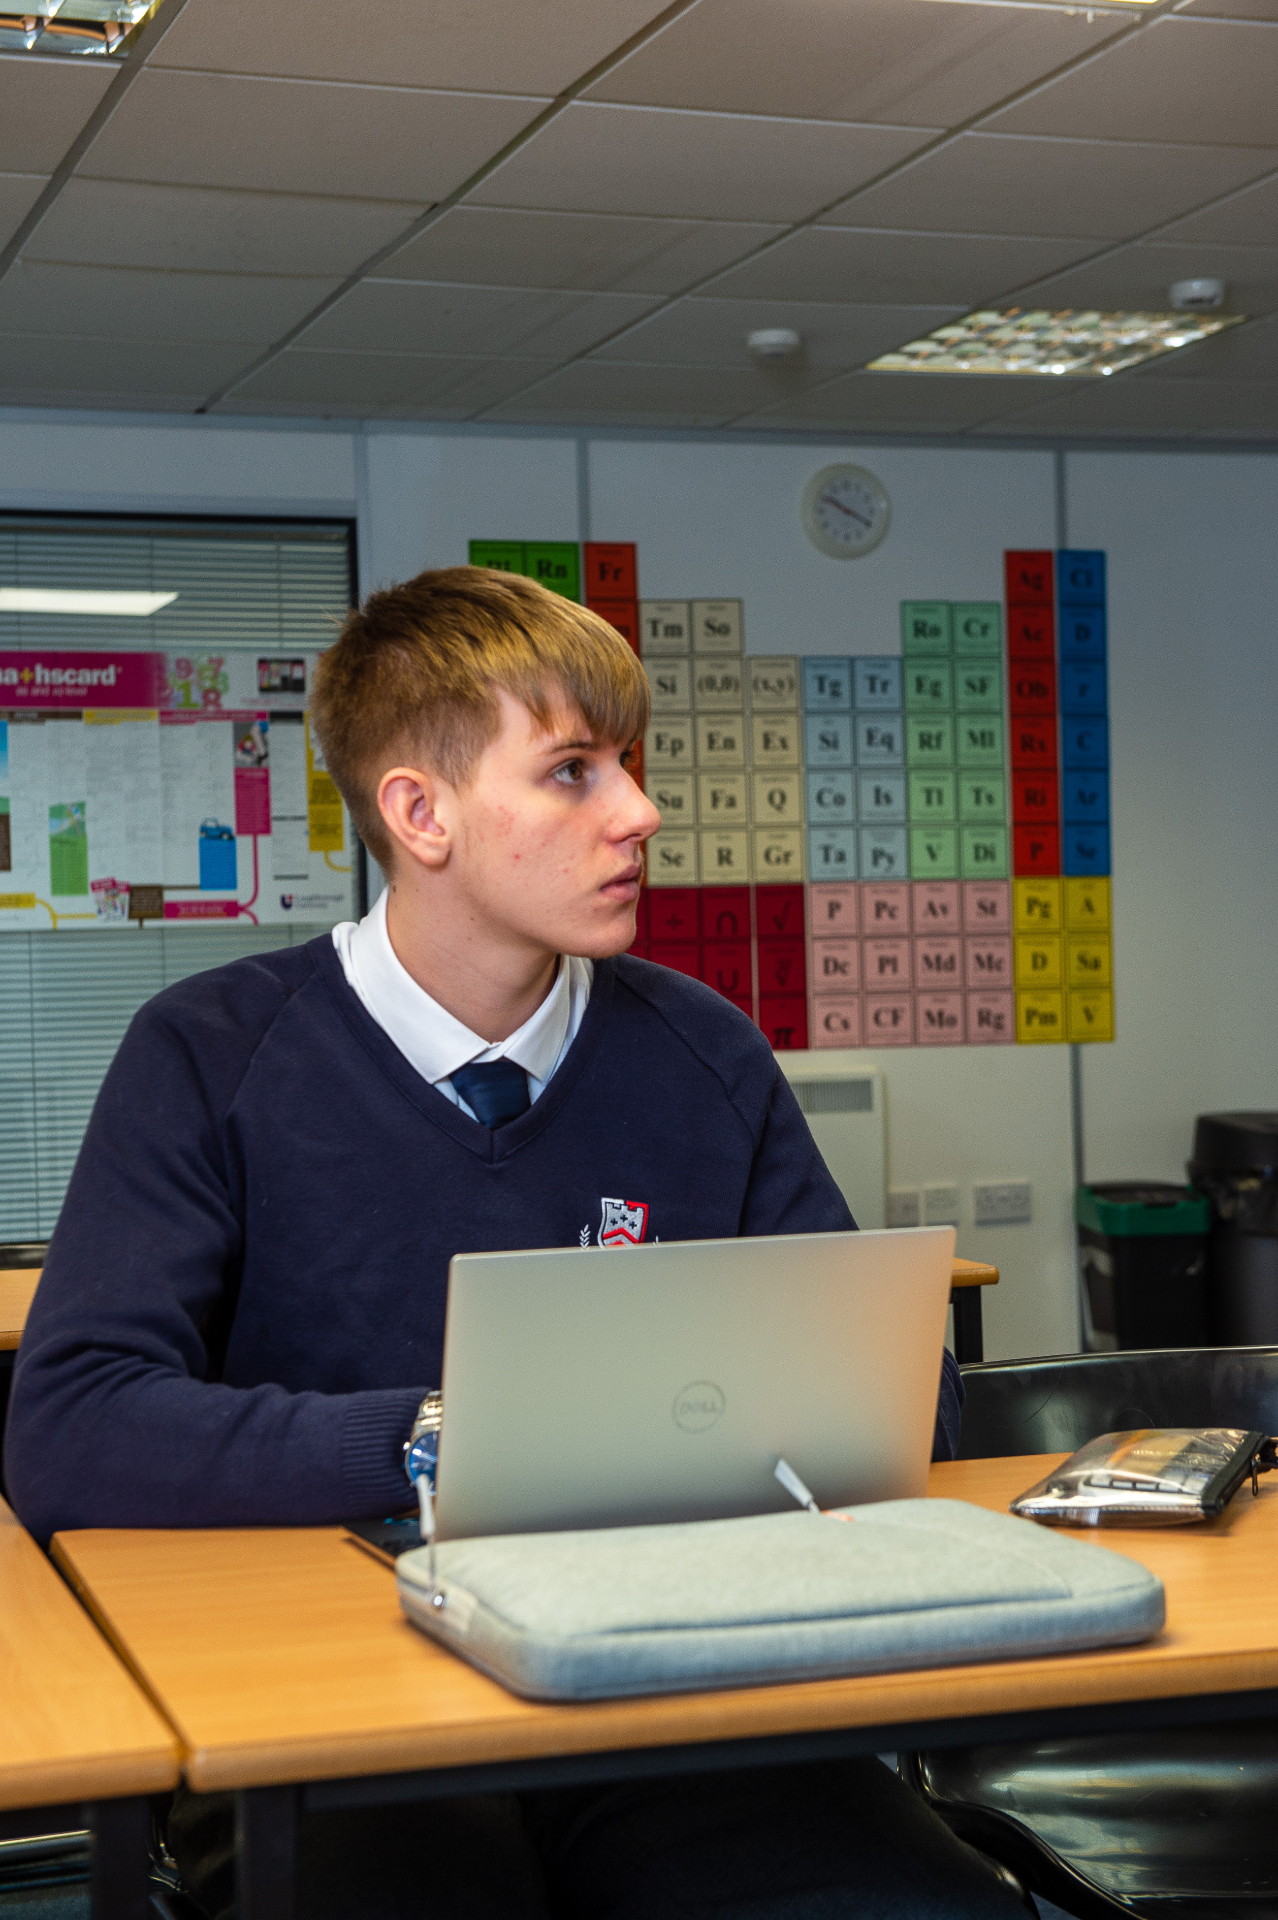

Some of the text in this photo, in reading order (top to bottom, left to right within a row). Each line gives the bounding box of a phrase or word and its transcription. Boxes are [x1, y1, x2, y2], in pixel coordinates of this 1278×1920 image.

[599, 560, 627, 581] Fr
[644, 618, 683, 638] Tm
[704, 617, 731, 638] So
[963, 617, 991, 638] Cr
[655, 676, 677, 695] Si
[814, 675, 842, 698] Tg
[866, 675, 890, 695] Tr
[654, 733, 685, 757] Ep
[707, 733, 736, 751] En
[762, 732, 789, 751] Ex
[865, 728, 895, 754] Eq
[710, 788, 737, 809] Fa
[767, 788, 788, 812] Q
[815, 786, 847, 808] Co
[717, 847, 734, 867] R
[763, 845, 794, 866] Gr
[818, 844, 847, 865] Ta
[925, 843, 943, 862] V
[827, 899, 843, 920] P
